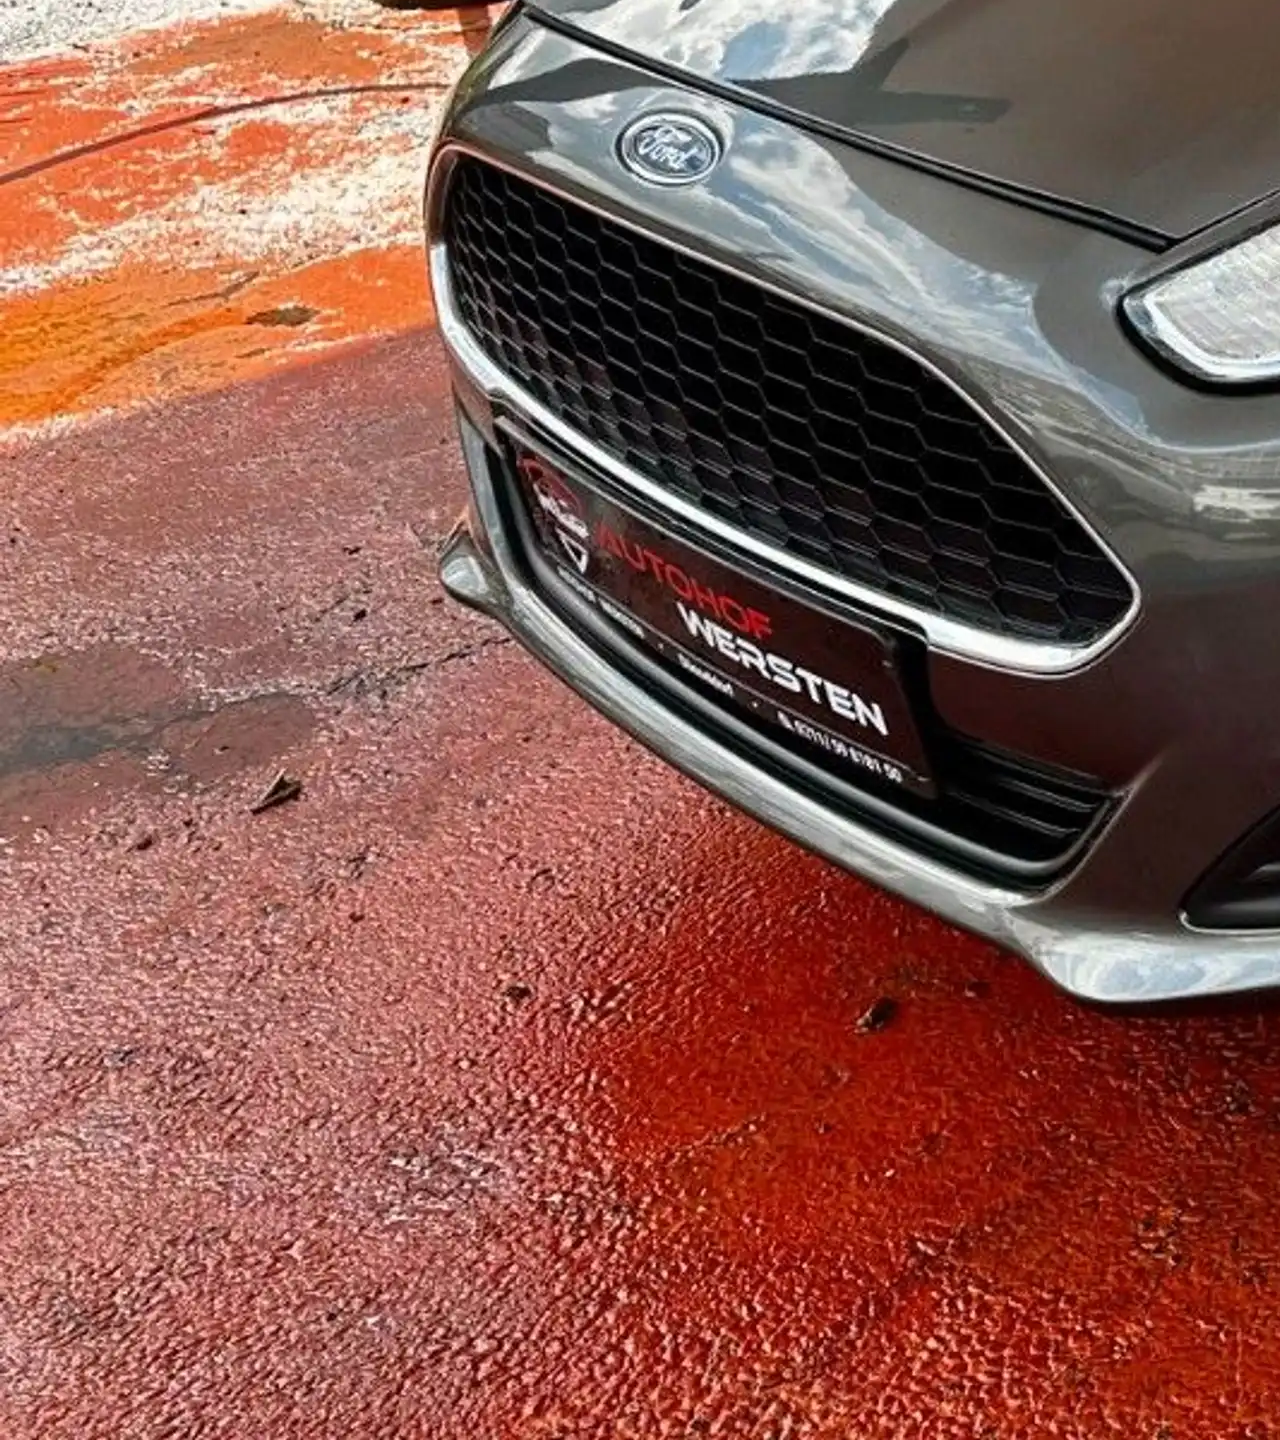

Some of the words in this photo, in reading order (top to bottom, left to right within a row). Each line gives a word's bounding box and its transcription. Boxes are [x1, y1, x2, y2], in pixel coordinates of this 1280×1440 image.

[638, 122, 700, 170] Ford
[594, 521, 773, 640] AUTOHOF
[676, 601, 889, 737] WERSTEN
